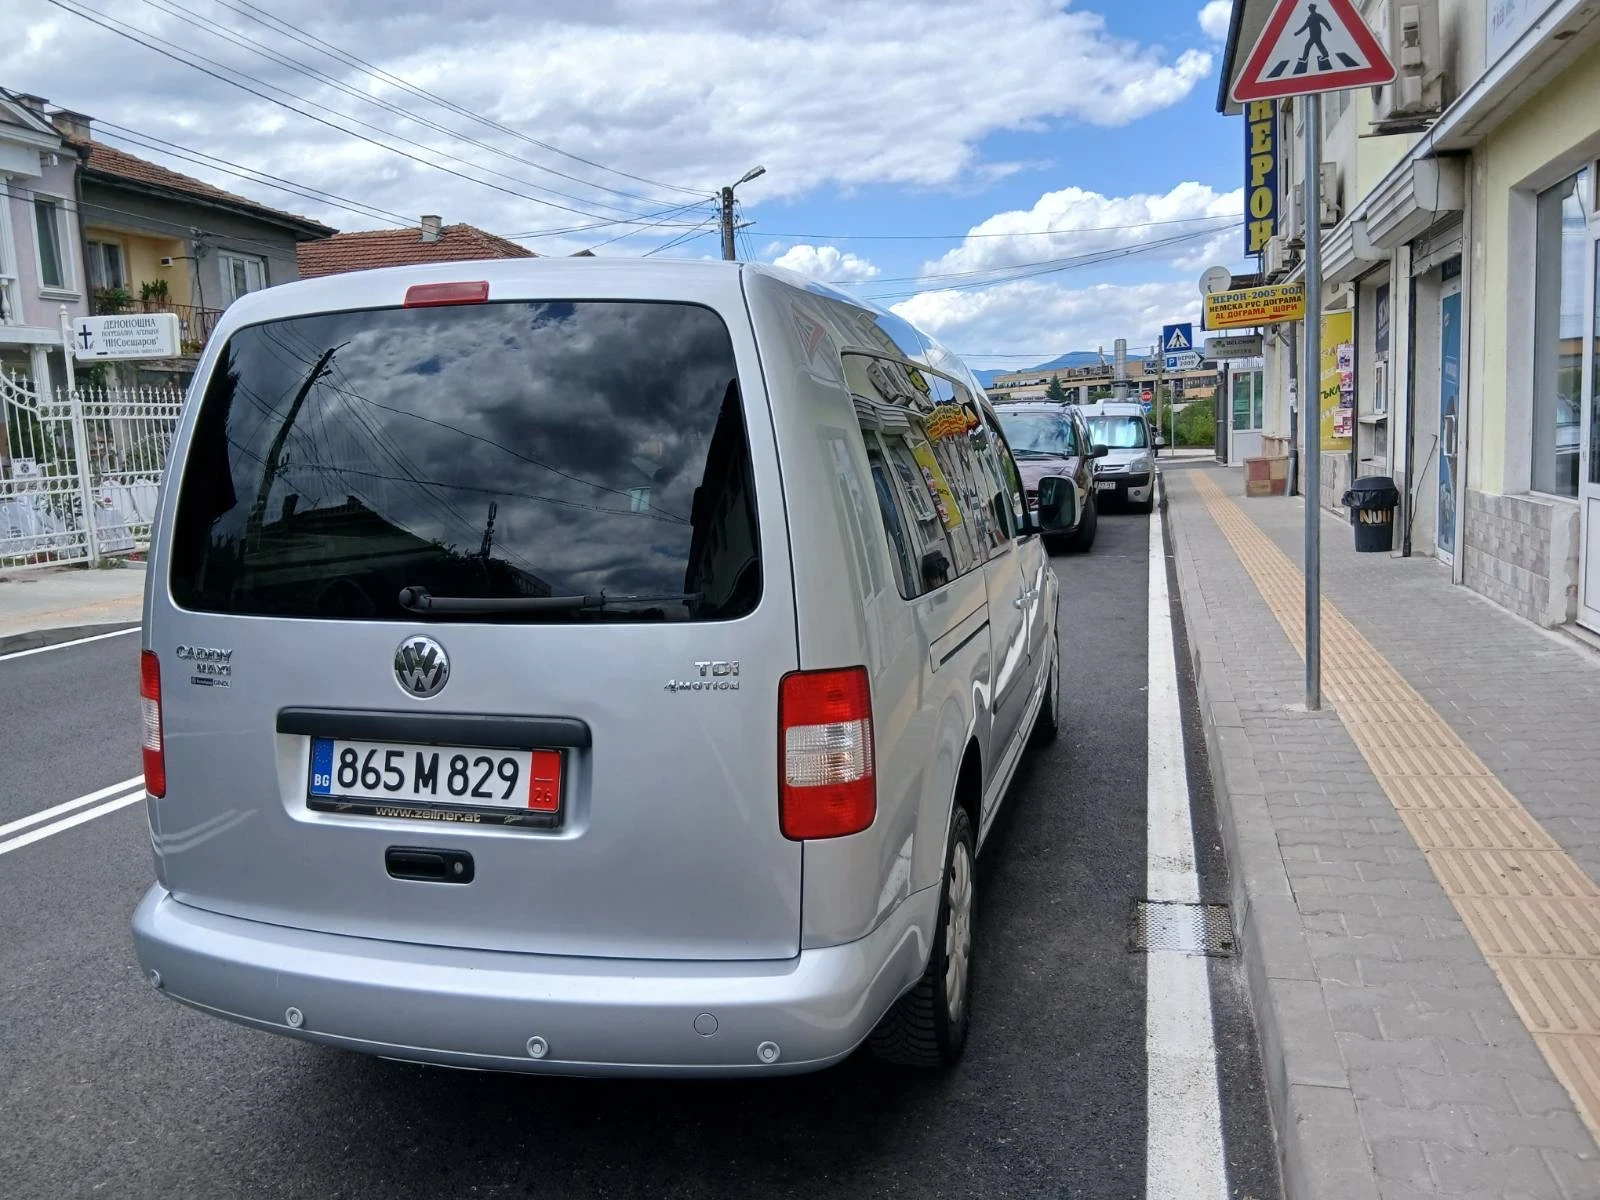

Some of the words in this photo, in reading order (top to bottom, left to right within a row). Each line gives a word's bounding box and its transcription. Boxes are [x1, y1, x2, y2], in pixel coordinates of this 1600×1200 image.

[1281, 286, 1303, 296] ООД
[1209, 302, 1243, 313] НЕМСКА
[1263, 296, 1302, 307] ДОГРАМА
[1227, 308, 1266, 319] ДОГРАМА
[103, 318, 156, 330] ДЕНОНОЩНА
[176, 645, 233, 663] CADDY
[664, 679, 740, 693] 4MOTION
[314, 774, 330, 787] BG
